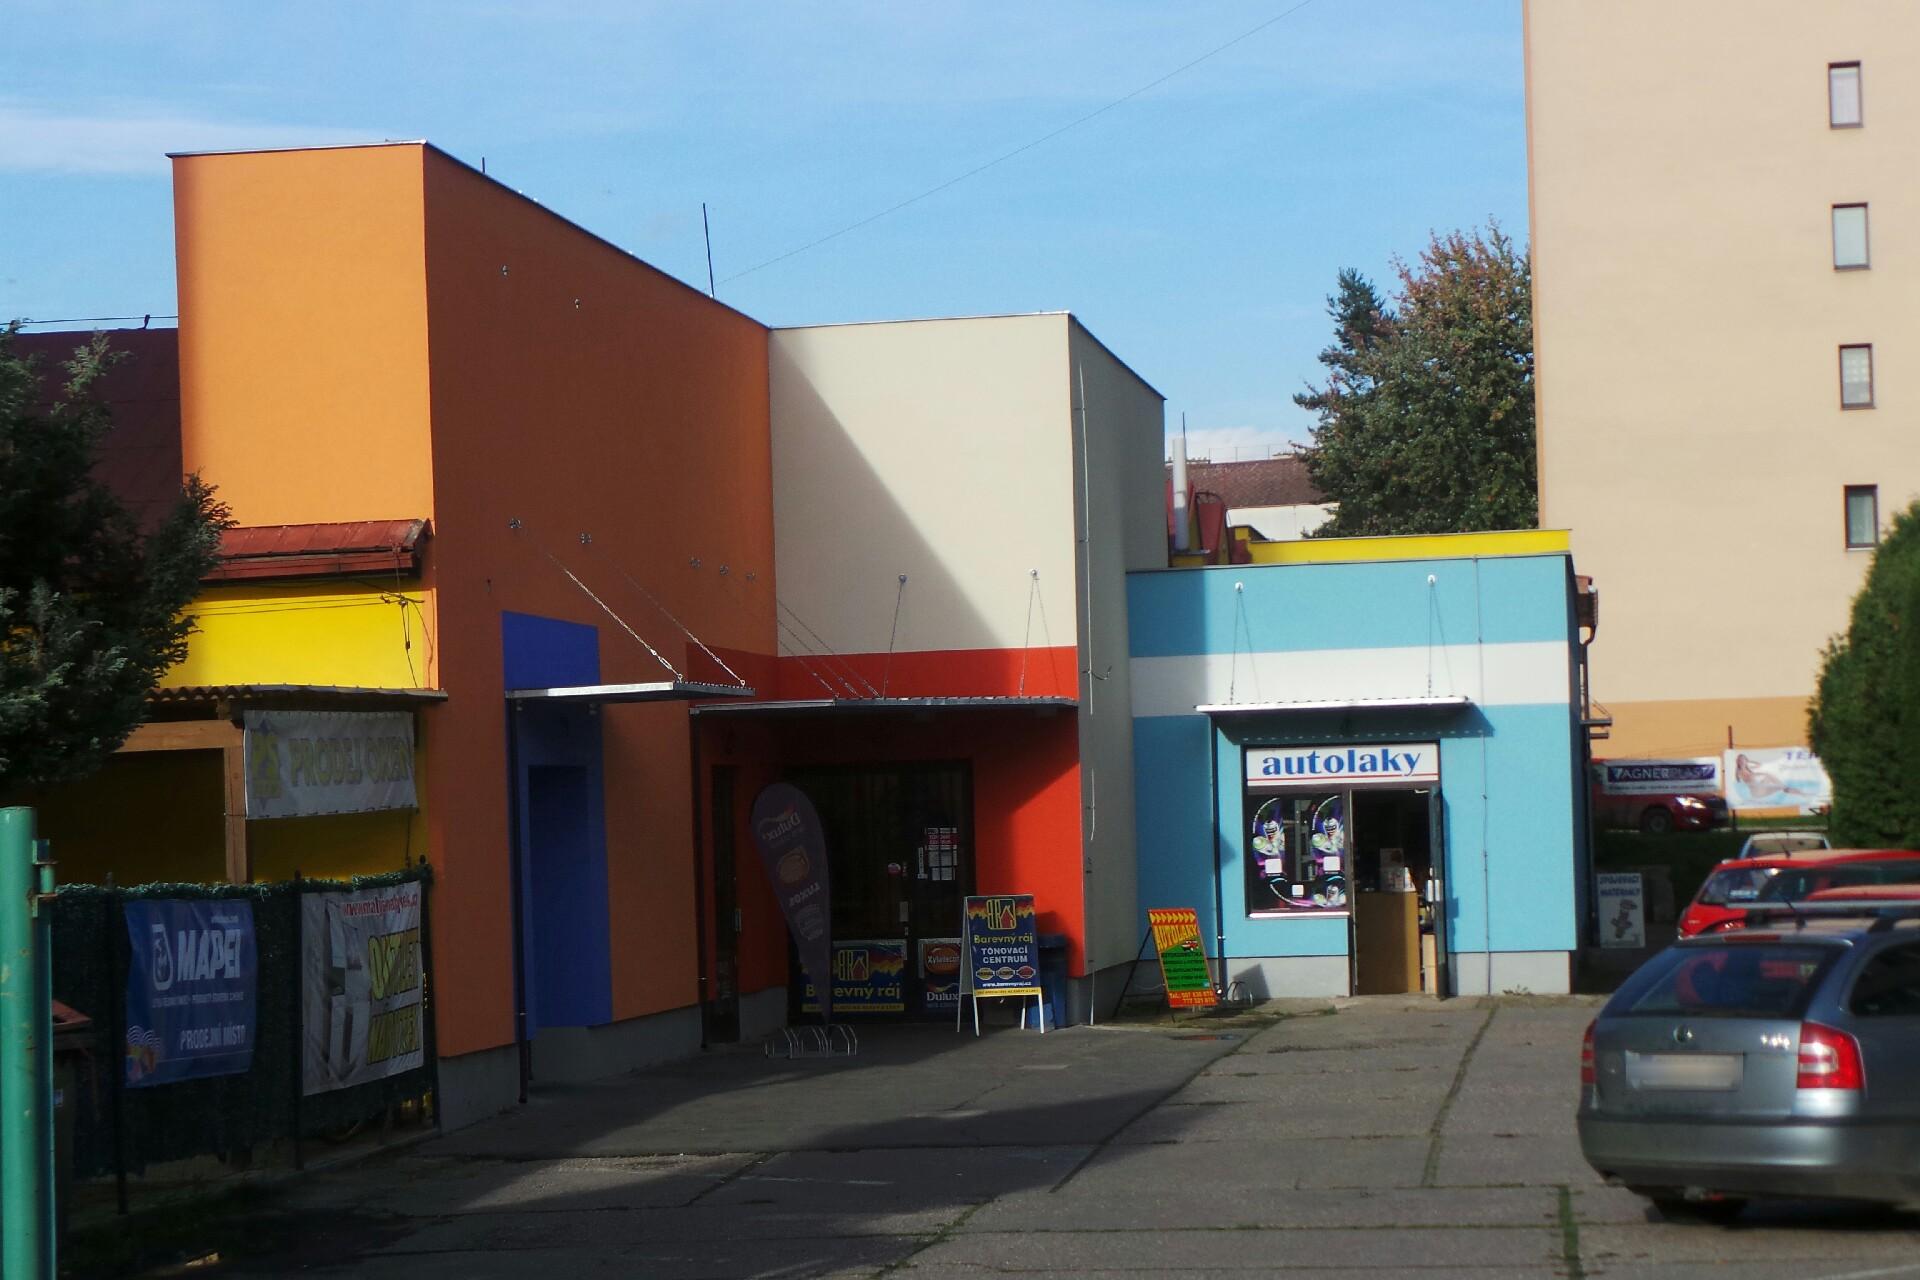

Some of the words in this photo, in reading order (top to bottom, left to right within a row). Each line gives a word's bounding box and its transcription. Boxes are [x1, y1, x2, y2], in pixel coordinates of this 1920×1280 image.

[287, 736, 363, 787] PRODEJ
[1262, 747, 1421, 777] autolaky
[974, 932, 1016, 945] Barevný
[1018, 932, 1033, 944] ráj
[1155, 924, 1198, 953] AUTOLAKY
[177, 928, 241, 982] MAPEI
[982, 955, 1028, 964] CENTRUM
[876, 982, 901, 1000] ráj
[926, 991, 959, 1002] Dulux
